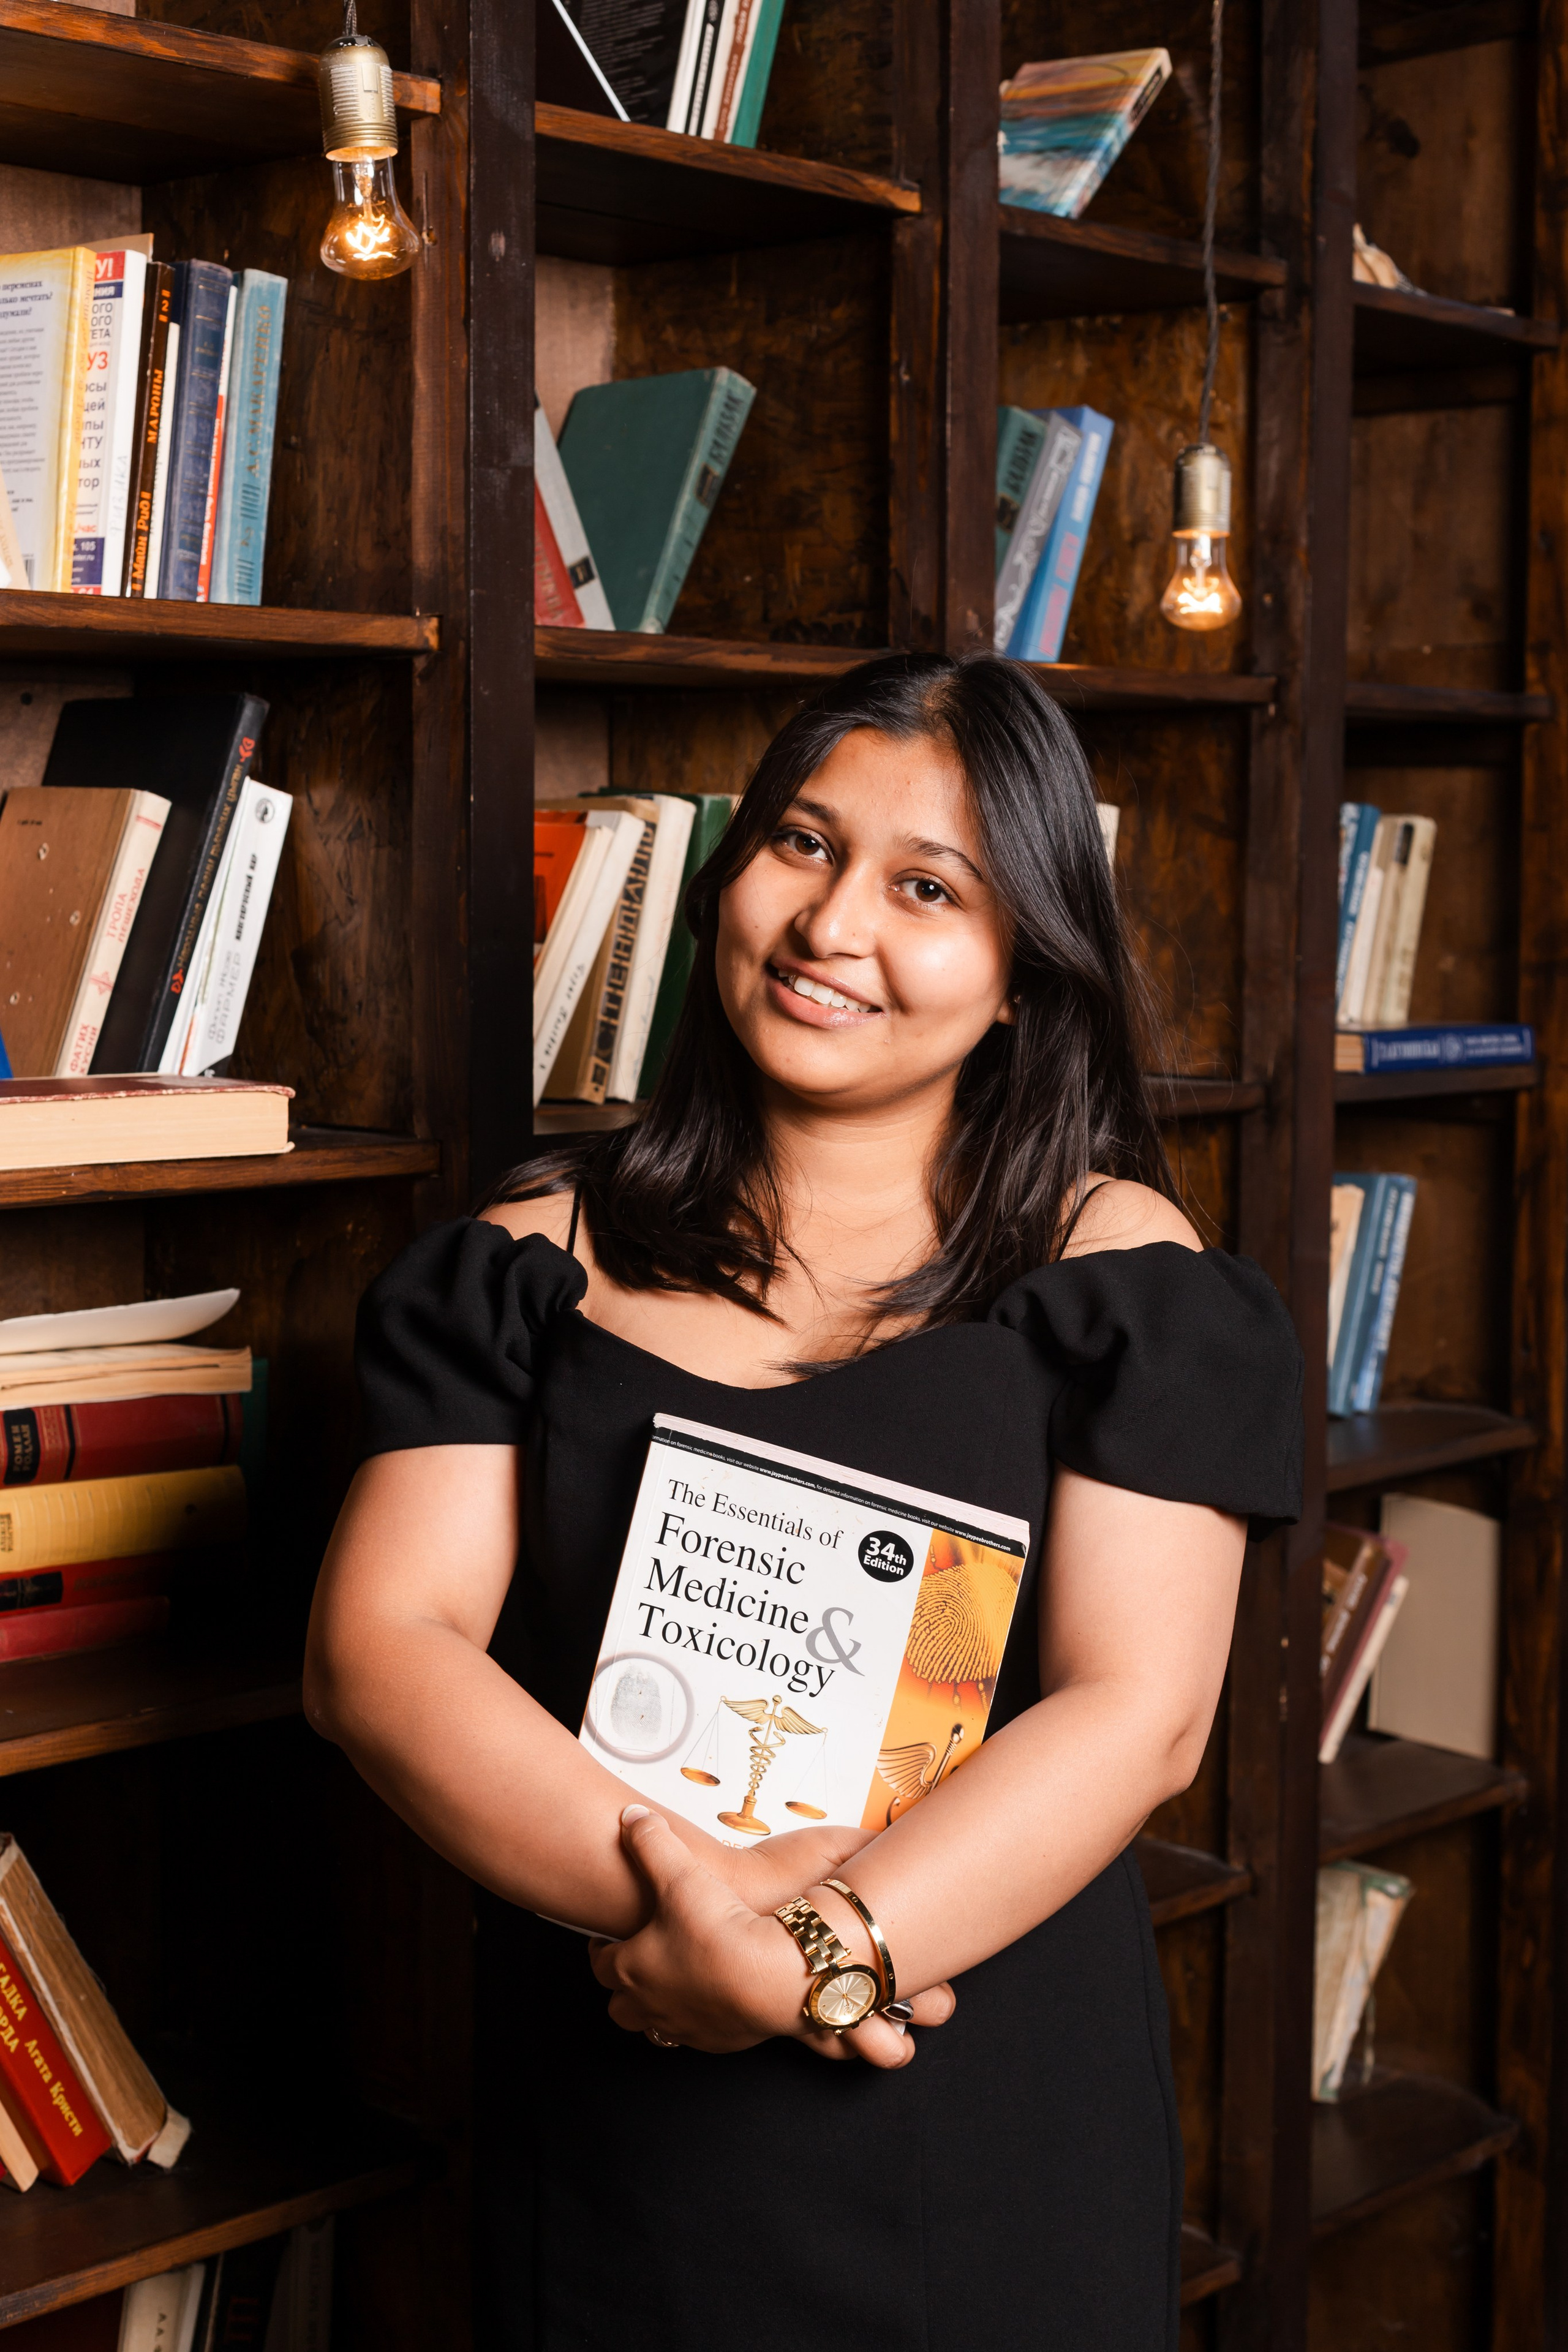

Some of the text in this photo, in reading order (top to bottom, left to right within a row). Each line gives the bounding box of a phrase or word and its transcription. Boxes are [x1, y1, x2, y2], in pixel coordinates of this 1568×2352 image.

[90, 328, 111, 339] ЕТА
[83, 420, 104, 430] пы
[146, 368, 164, 444] МАРОНЫ
[132, 499, 151, 579] Майн Рид
[105, 891, 129, 940] ТРОПА
[116, 867, 146, 943] ПЕШЕХОДА
[68, 1022, 91, 1073] ФАТИХ
[668, 1479, 845, 1550] The Essentials of
[676, 1441, 693, 1451] forensic
[712, 1452, 726, 1461] books,
[743, 1461, 760, 1471] website
[760, 1467, 816, 1488] www.jaypeebrothers.com,
[823, 1486, 840, 1496] detailed
[840, 1491, 865, 1504] information
[870, 1501, 888, 1512] forensic
[888, 1506, 907, 1518] medicine
[907, 1512, 921, 1523] books,
[938, 1523, 955, 1533] website
[955, 1528, 1011, 1551] www.jaypeebrothers.com
[654, 1511, 805, 1585] Forensic
[863, 1554, 905, 1576] Edition
[865, 1536, 907, 1566] 34th
[638, 1602, 836, 1698] Toxicology
[643, 1556, 866, 1677] Medicine &
[24, 2039, 83, 2138] Агата Кристи
